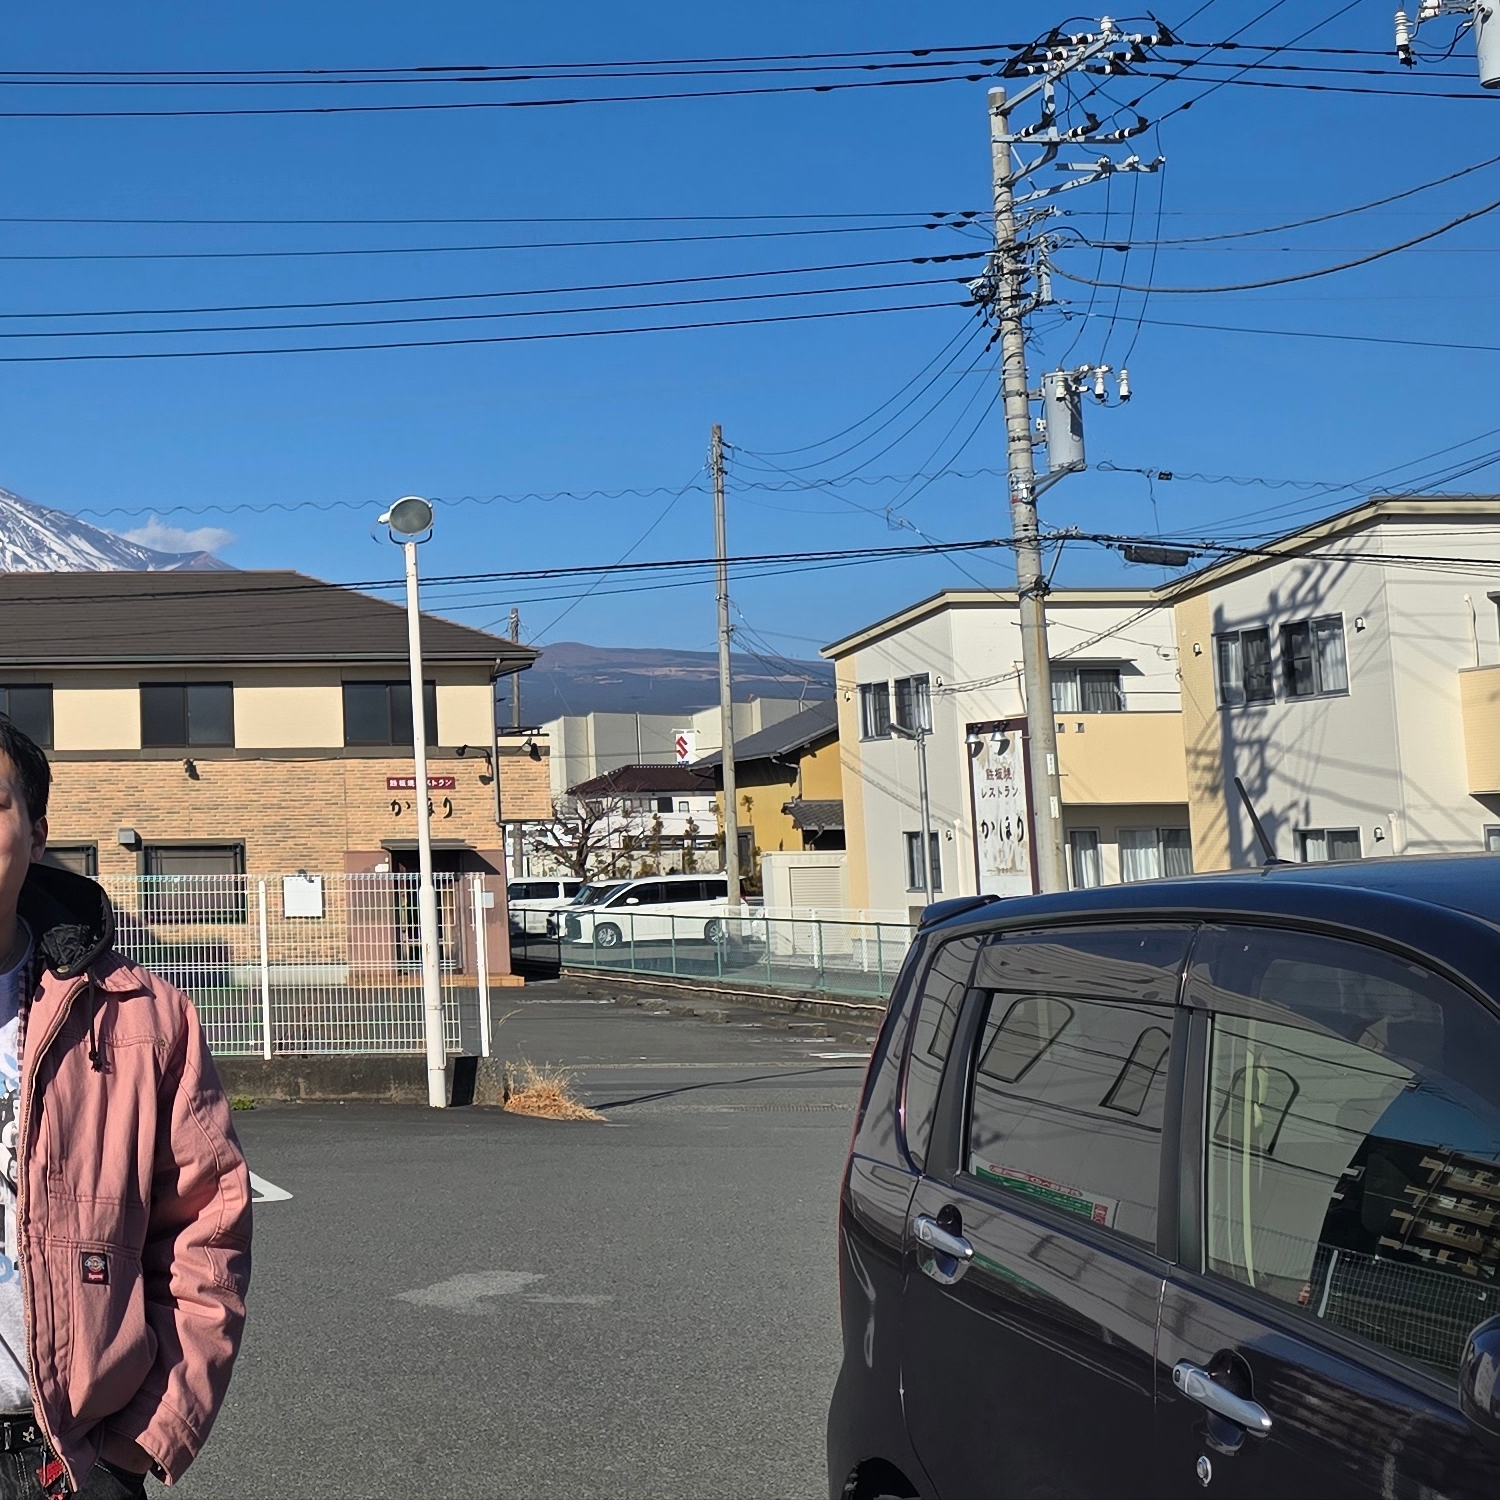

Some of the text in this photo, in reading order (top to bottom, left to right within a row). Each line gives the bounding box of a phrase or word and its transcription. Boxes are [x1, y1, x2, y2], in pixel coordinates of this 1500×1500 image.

[389, 779, 453, 788] 鉄板焼トラン
[981, 785, 1019, 799] レストラン
[980, 815, 1025, 843] かほり
